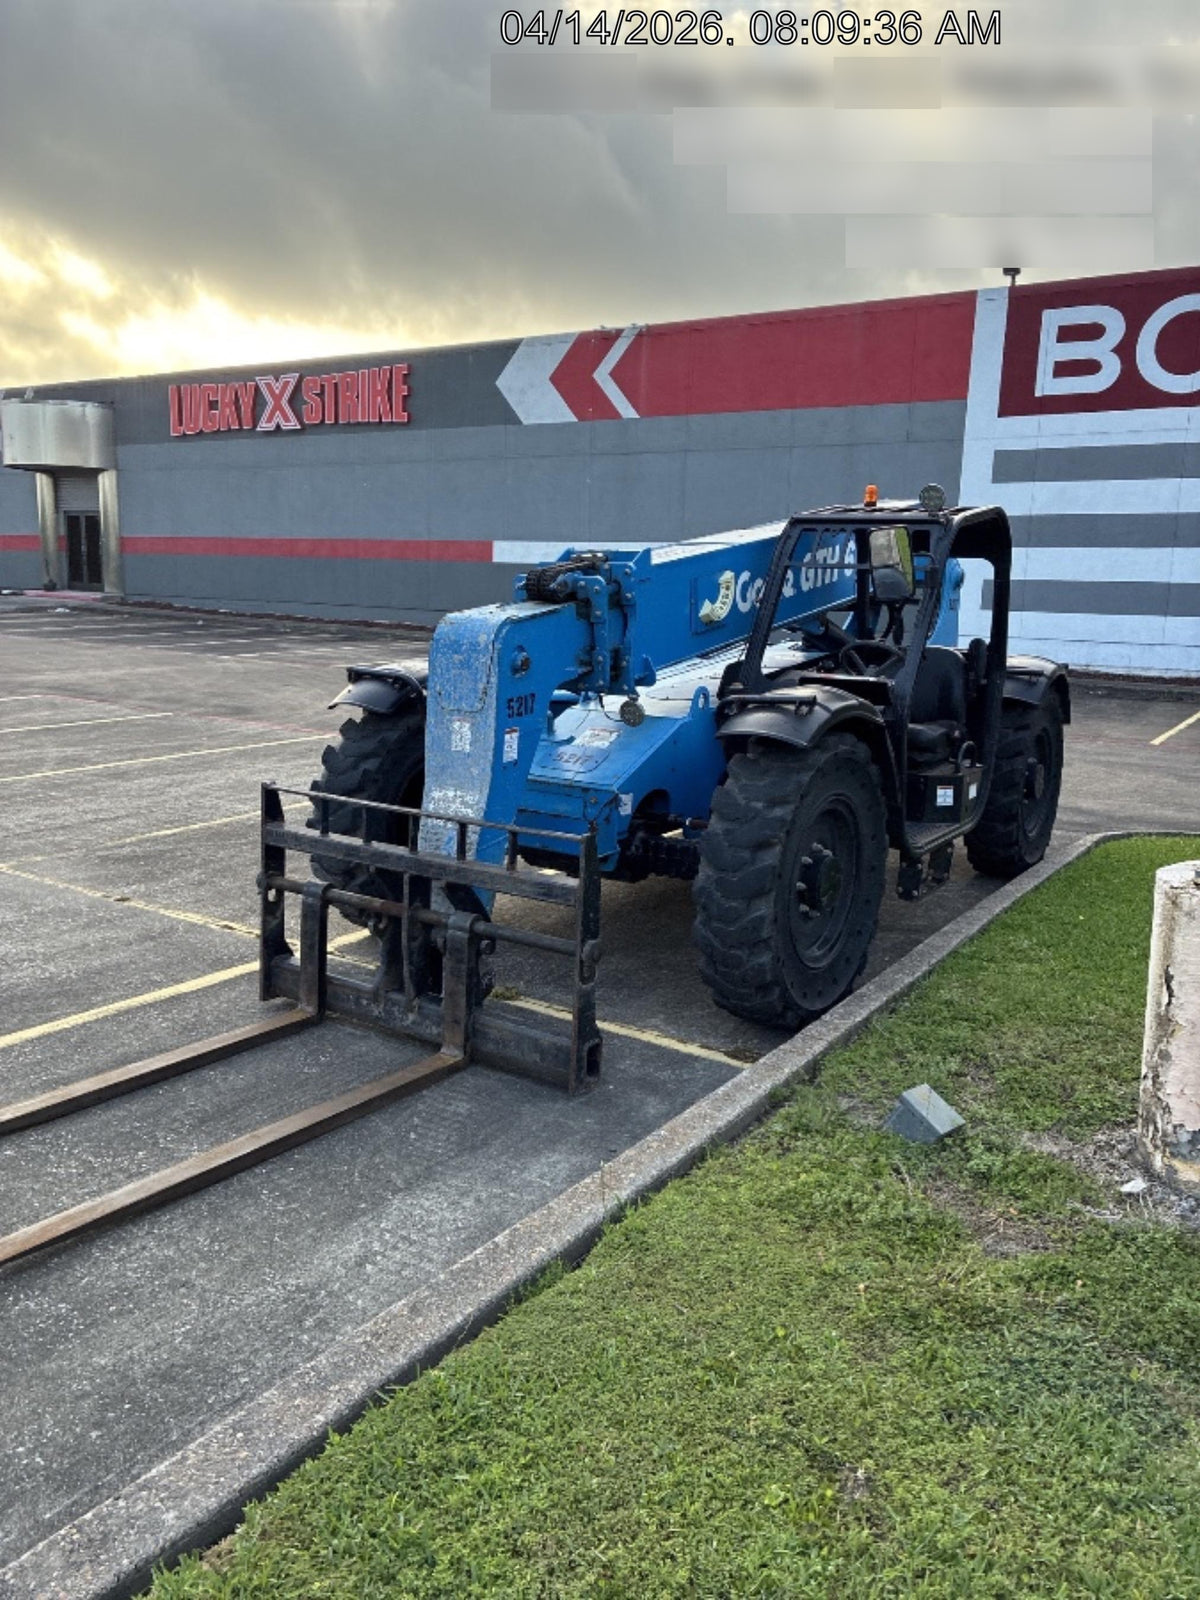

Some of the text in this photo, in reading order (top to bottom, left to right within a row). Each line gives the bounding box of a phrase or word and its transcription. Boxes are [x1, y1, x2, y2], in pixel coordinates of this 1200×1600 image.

[168, 363, 409, 436] LUCKY X STRIKE
[506, 692, 537, 719] 5217
[556, 751, 594, 769] 5217
